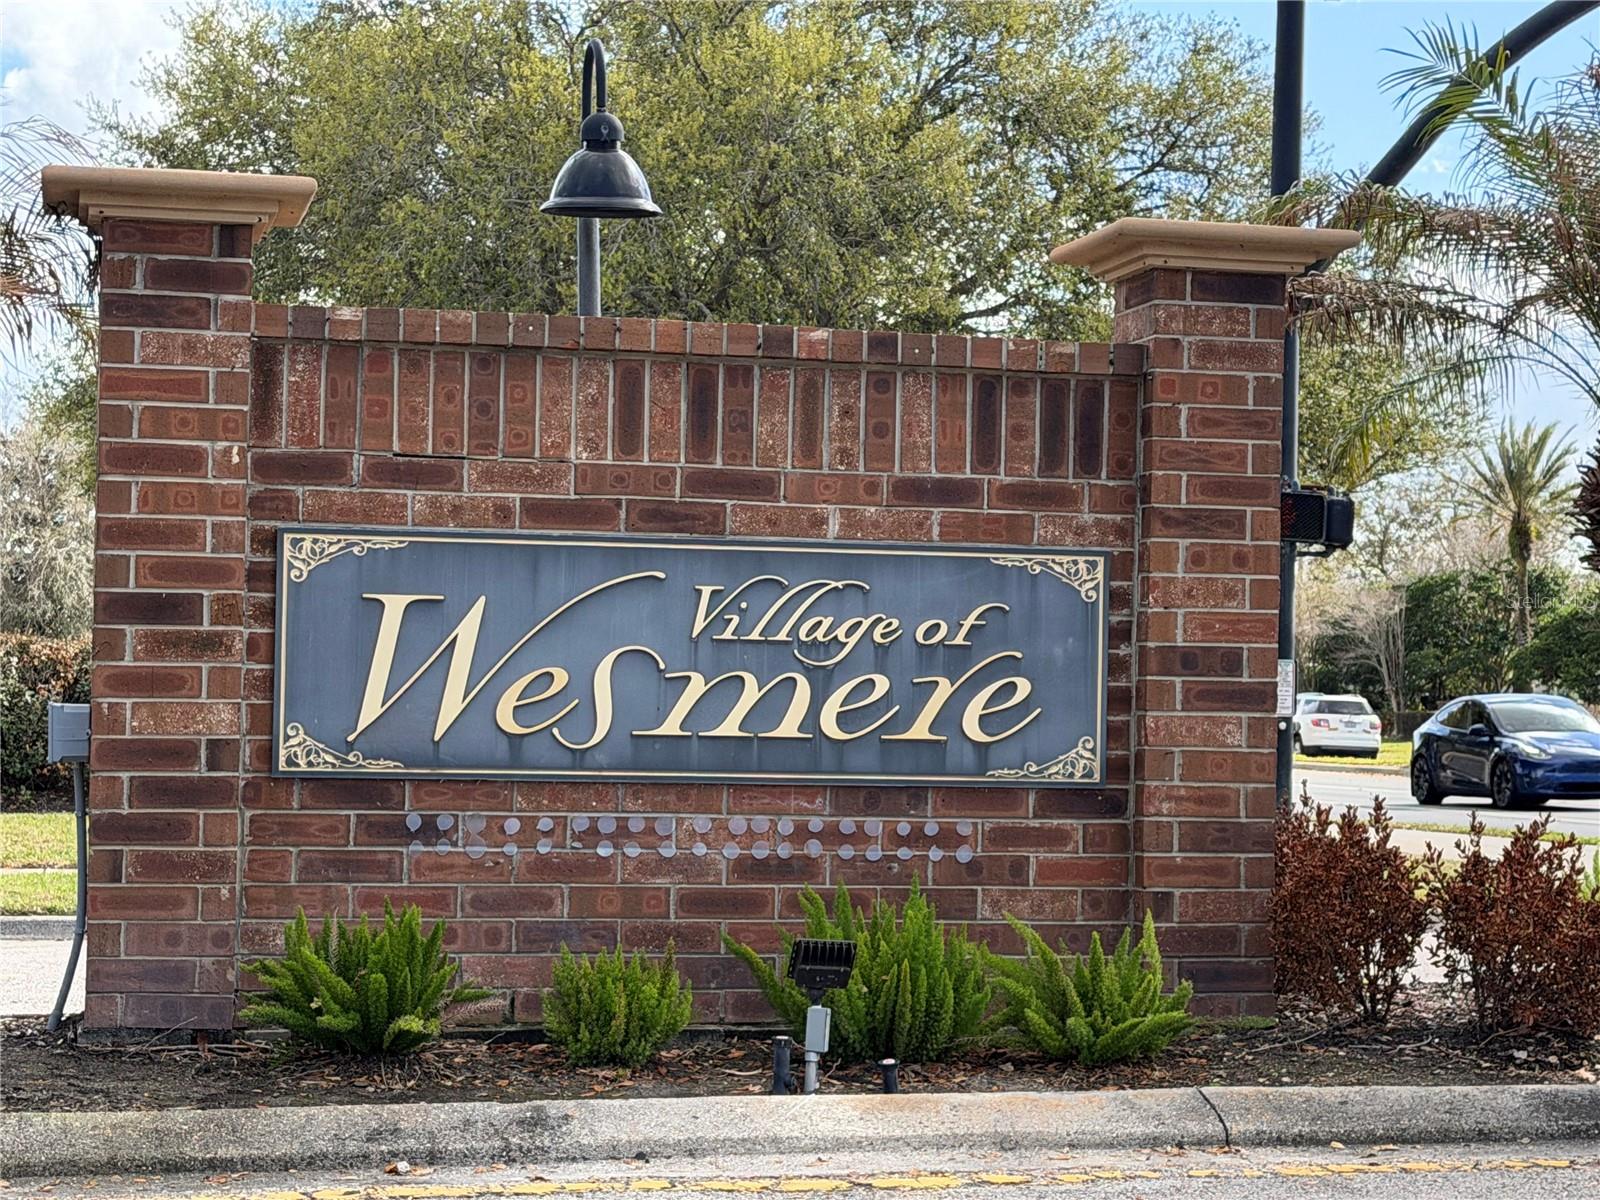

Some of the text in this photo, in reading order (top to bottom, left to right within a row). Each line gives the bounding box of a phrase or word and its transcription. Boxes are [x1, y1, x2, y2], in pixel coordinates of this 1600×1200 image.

[346, 570, 1042, 750] Wesmere
[691, 574, 1010, 667] Village of
